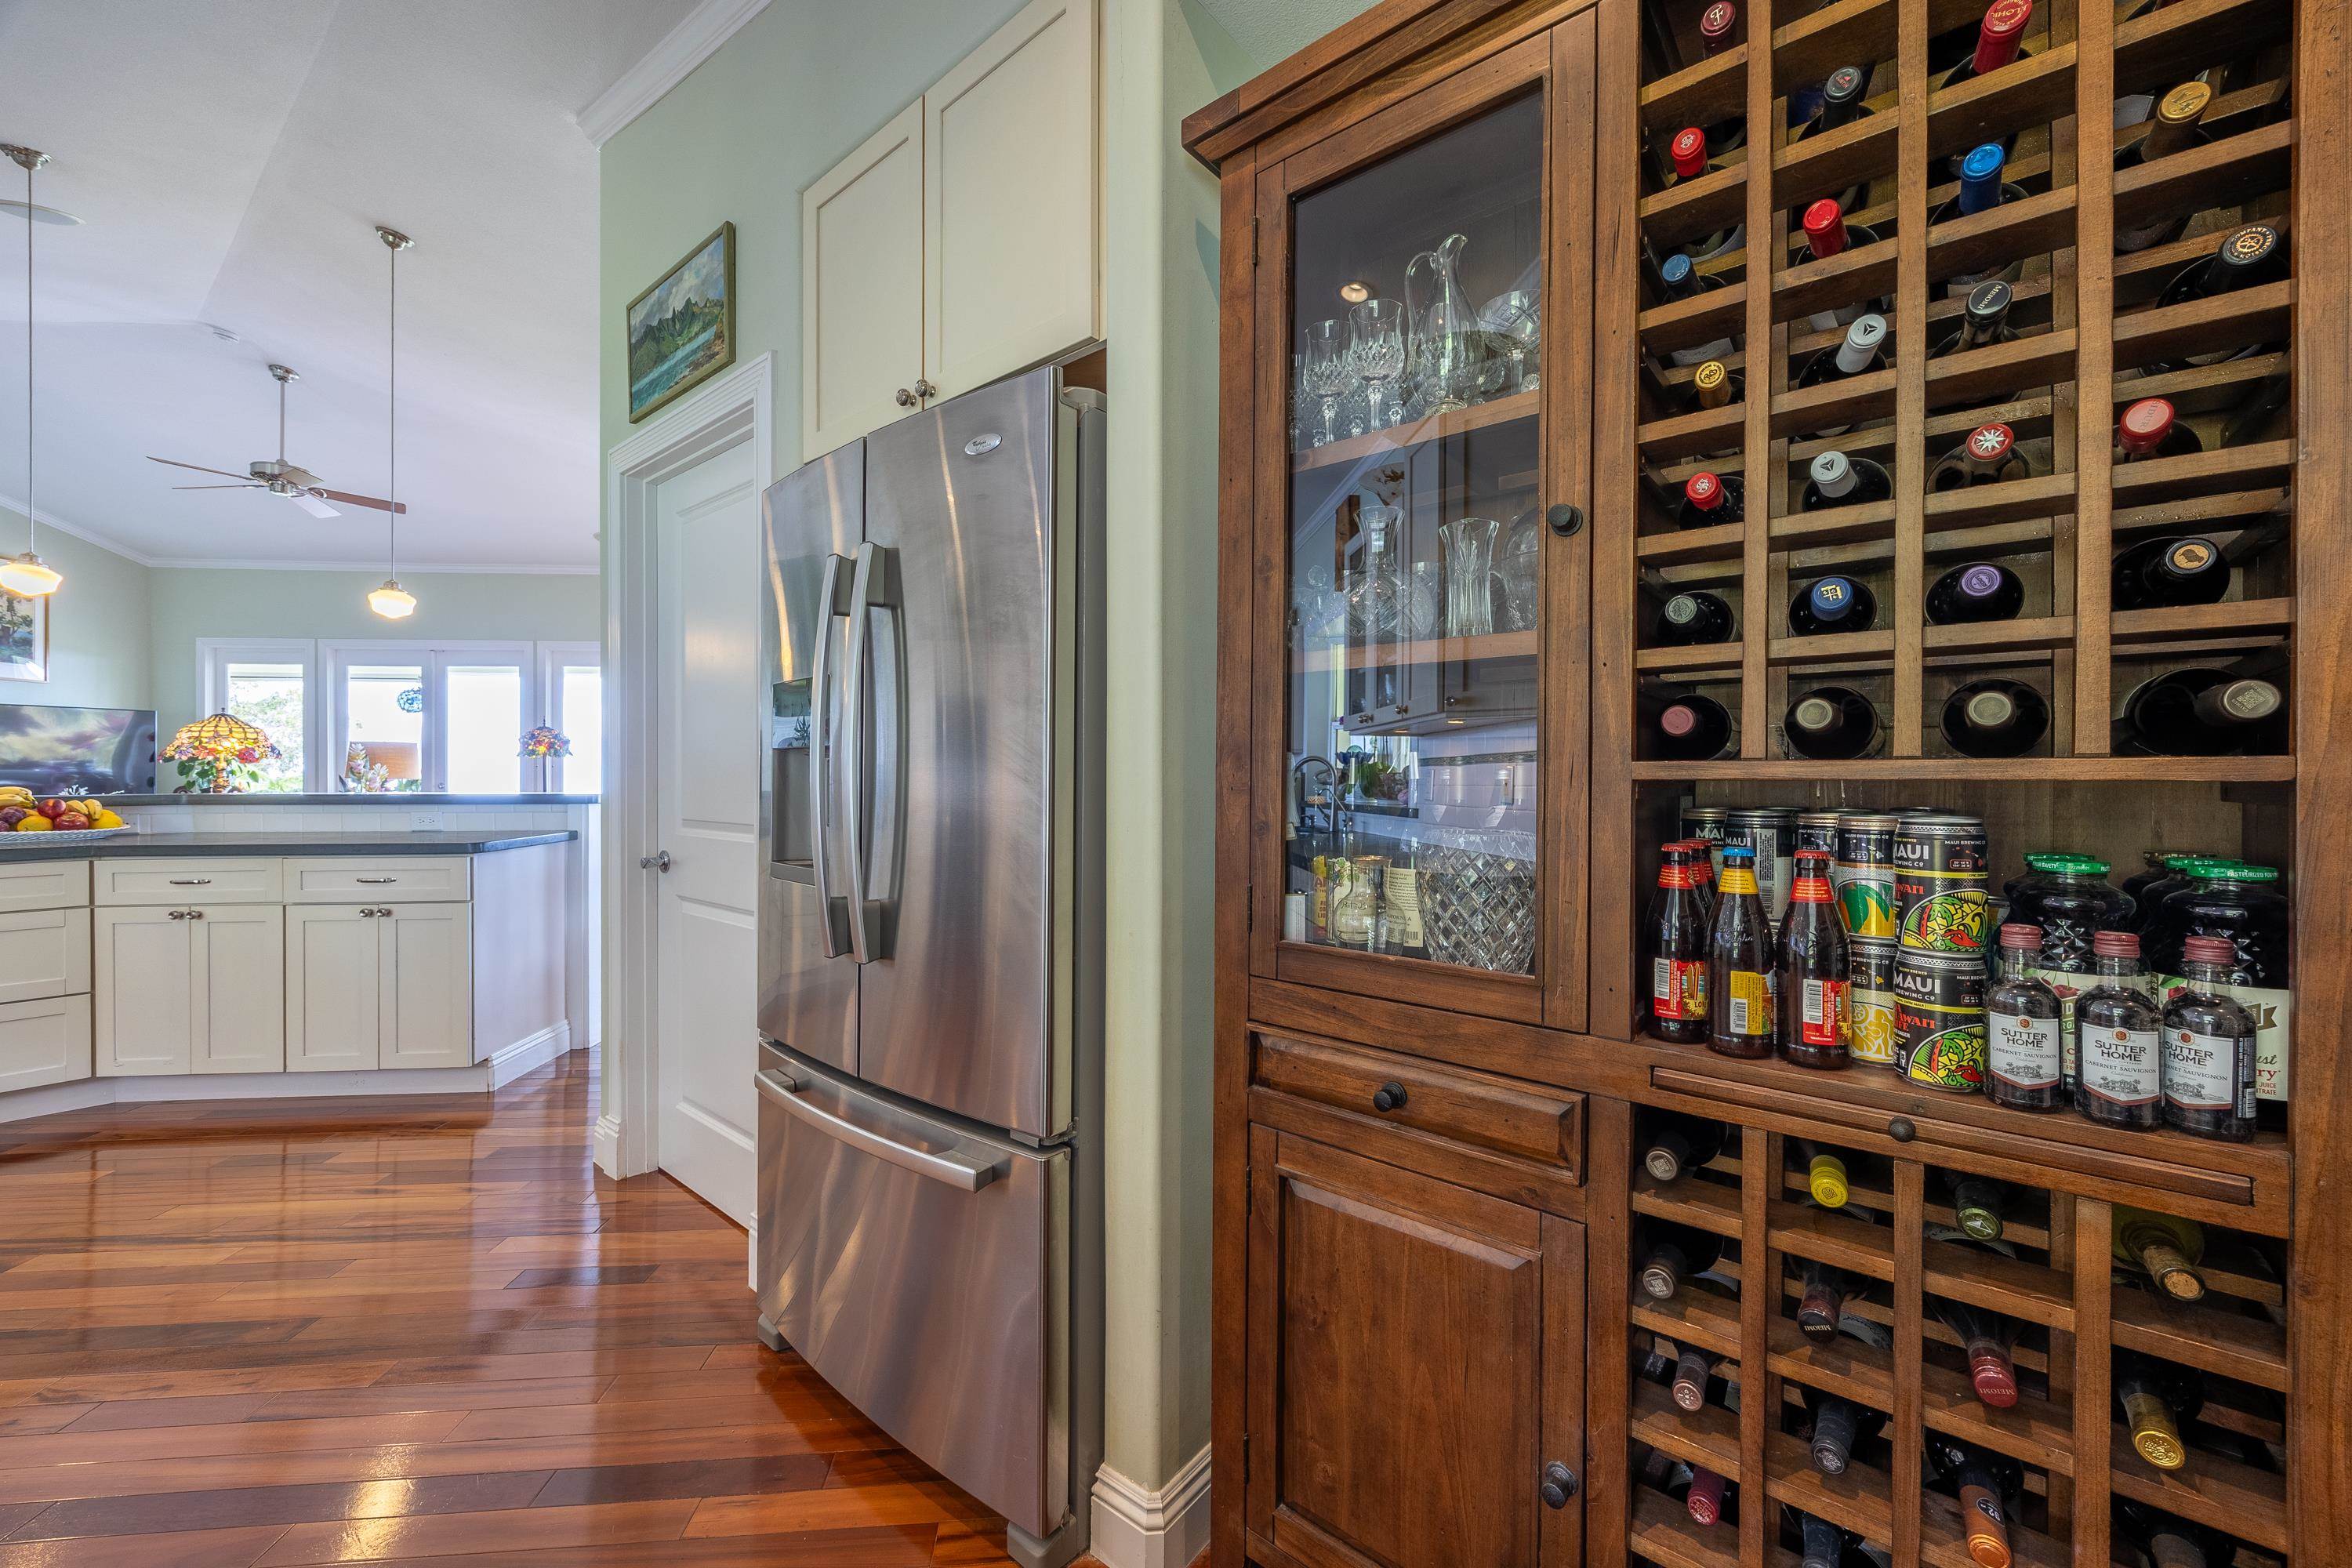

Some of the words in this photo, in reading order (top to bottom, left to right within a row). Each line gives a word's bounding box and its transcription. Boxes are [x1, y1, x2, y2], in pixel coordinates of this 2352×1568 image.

[1977, 285, 2002, 310] MEIOMI
[1725, 837, 1751, 846] MAUI
[1893, 971, 1940, 994] MAUI
[1896, 988, 1922, 1000] BREWING
[2001, 1027, 2049, 1041] SUTTER
[2006, 1036, 2044, 1048] HOME
[2094, 1040, 2147, 1054] SUTTER
[1992, 1046, 2021, 1057] CABERNET
[2101, 1049, 2142, 1062] HOME
[2165, 1040, 2214, 1059] SUTTER
[2085, 1059, 2118, 1070] CABERNET
[2169, 1051, 2207, 1066] HOME
[2183, 1069, 2227, 1081] SAUVIGNON
